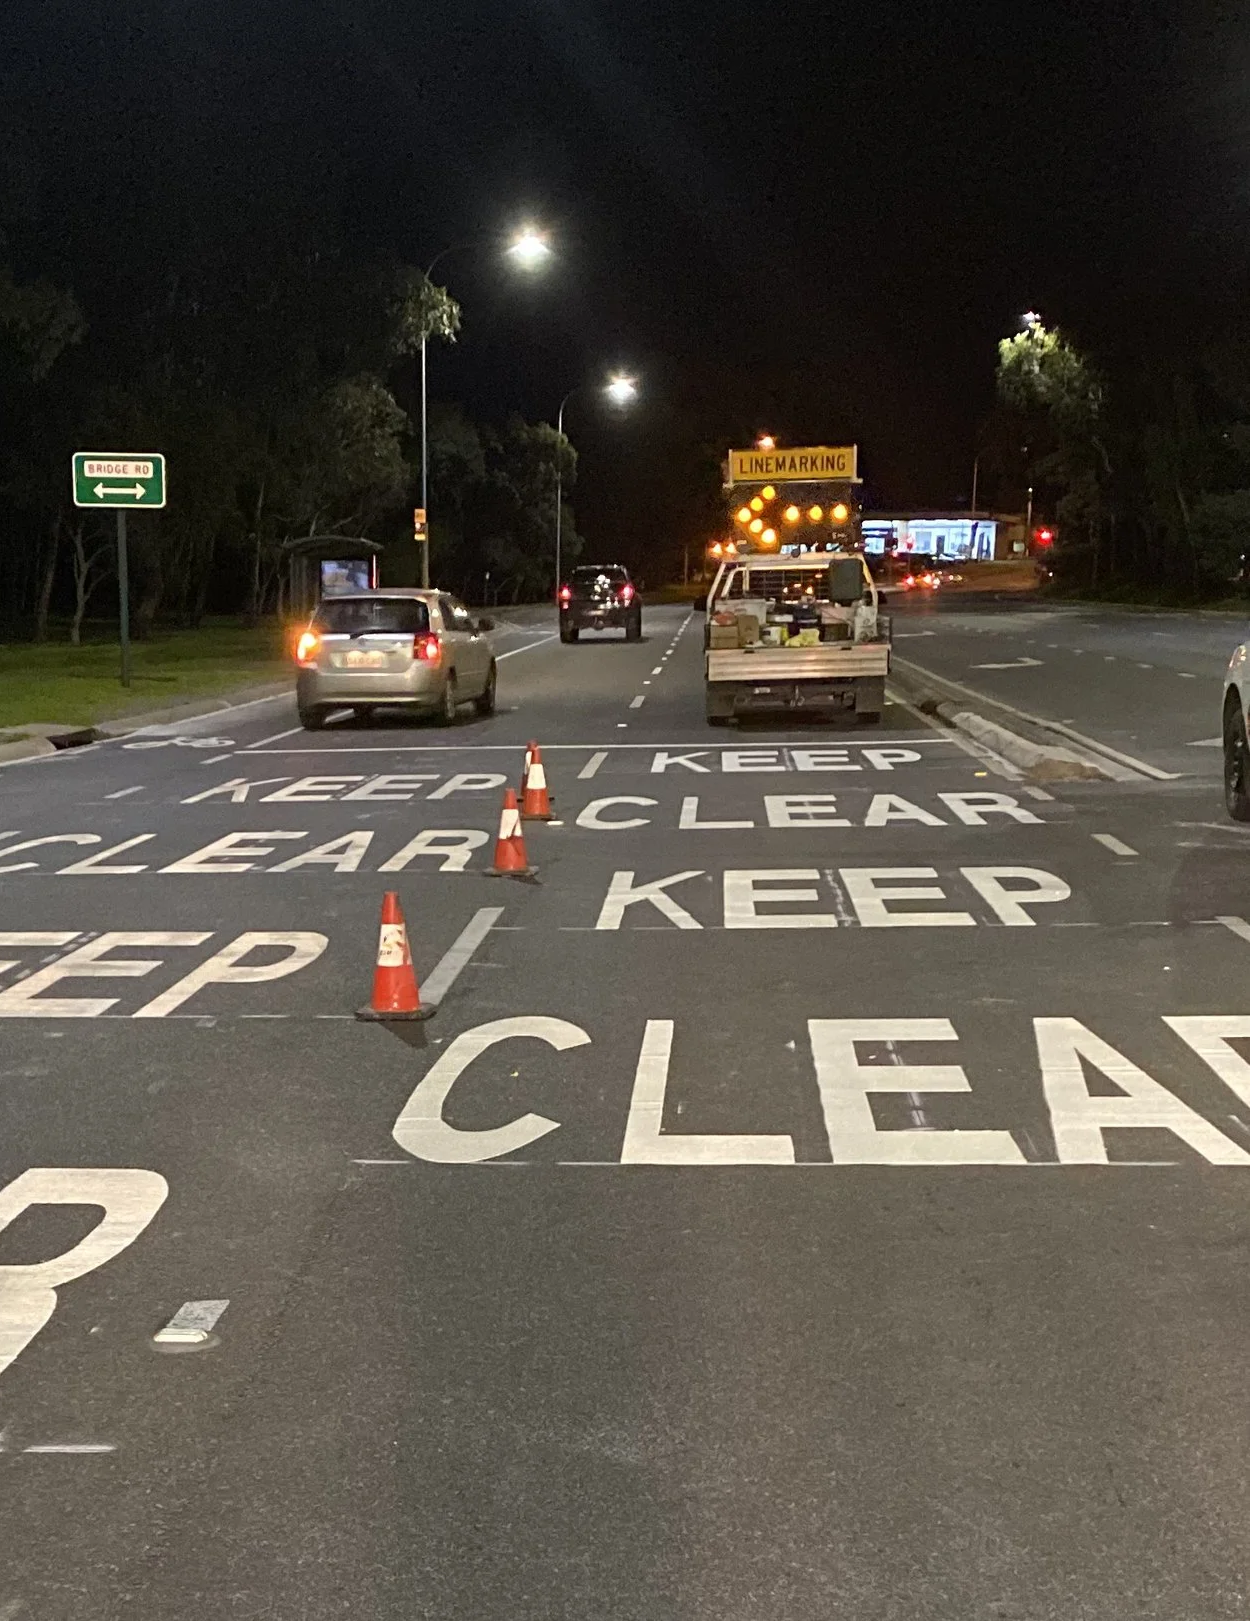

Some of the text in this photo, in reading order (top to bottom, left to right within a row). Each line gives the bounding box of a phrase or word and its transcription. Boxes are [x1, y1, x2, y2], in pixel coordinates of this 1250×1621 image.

[88, 464, 149, 475] BRIDGE RD
[739, 454, 846, 474] LINEMARKING
[651, 748, 922, 773] KEEP
[180, 773, 507, 803] KEEP
[576, 792, 1047, 829] CLEAR
[595, 866, 1072, 930] KEEP
